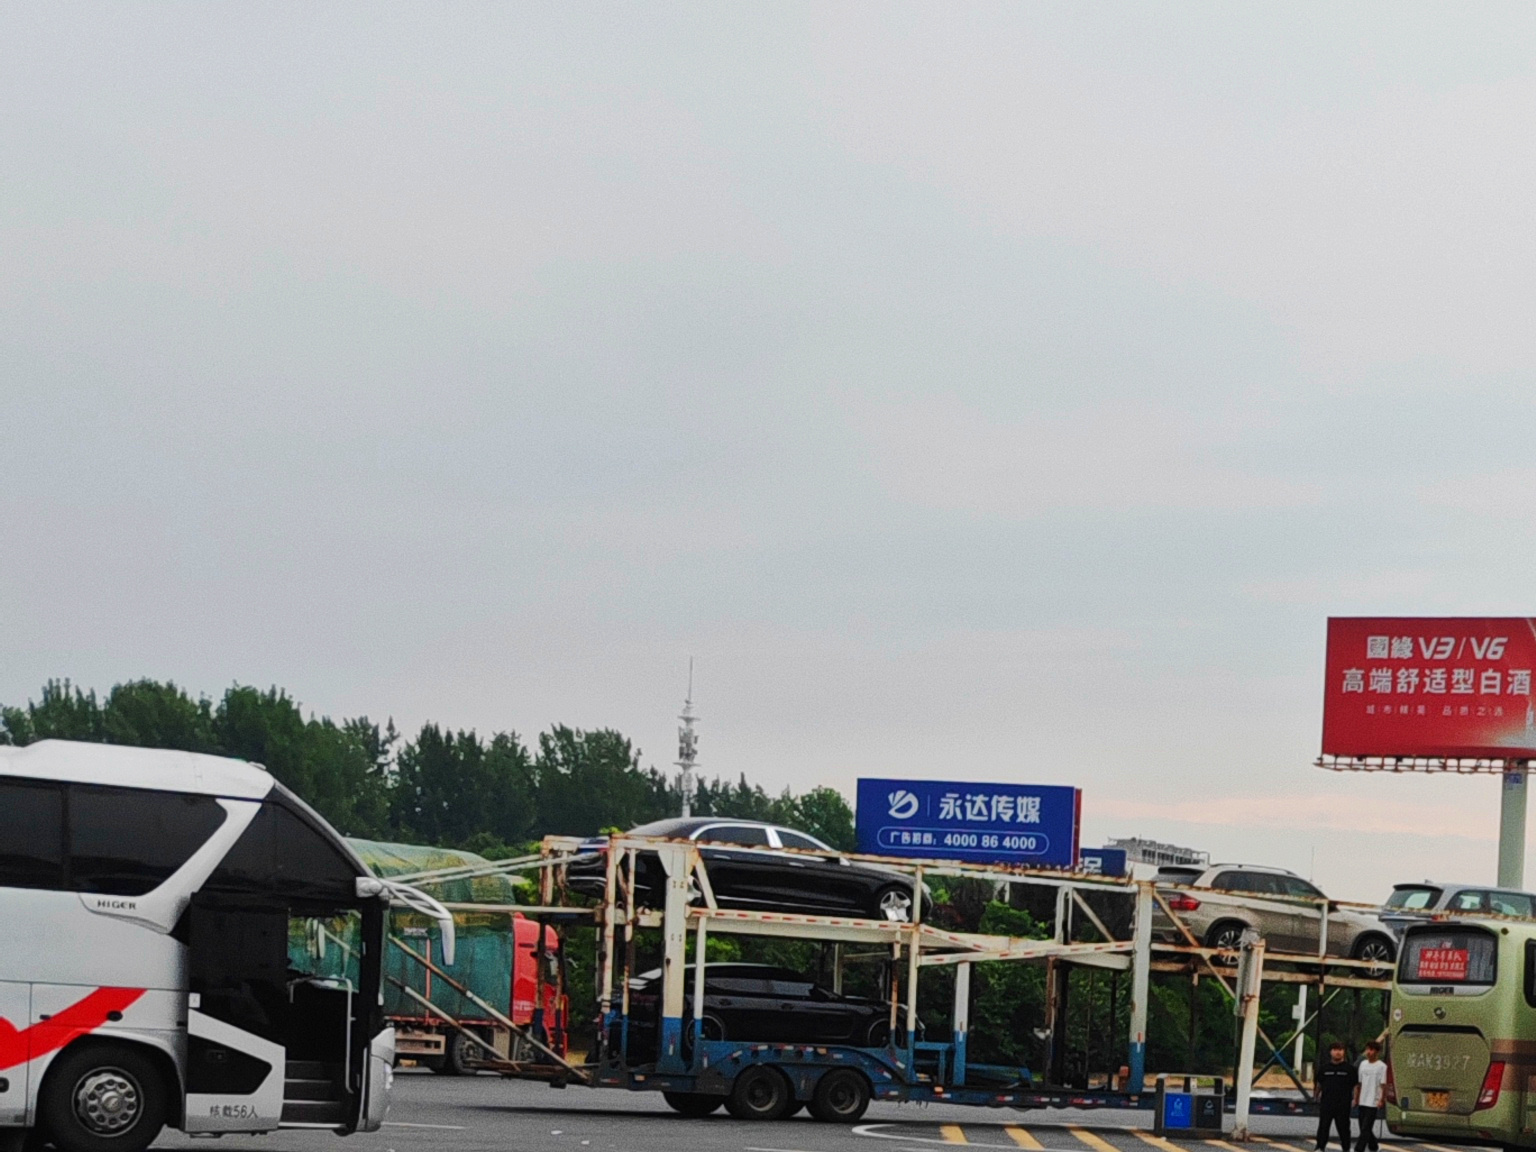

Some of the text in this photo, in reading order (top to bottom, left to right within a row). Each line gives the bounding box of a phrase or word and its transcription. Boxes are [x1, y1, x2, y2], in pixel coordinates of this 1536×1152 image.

[1342, 667, 1532, 695] 高端舒适型白酒
[938, 793, 1041, 823] 永达传媒
[944, 834, 978, 847] 4000
[981, 835, 999, 848] 86
[1002, 836, 1036, 850] 4000
[97, 900, 136, 910] HIGER
